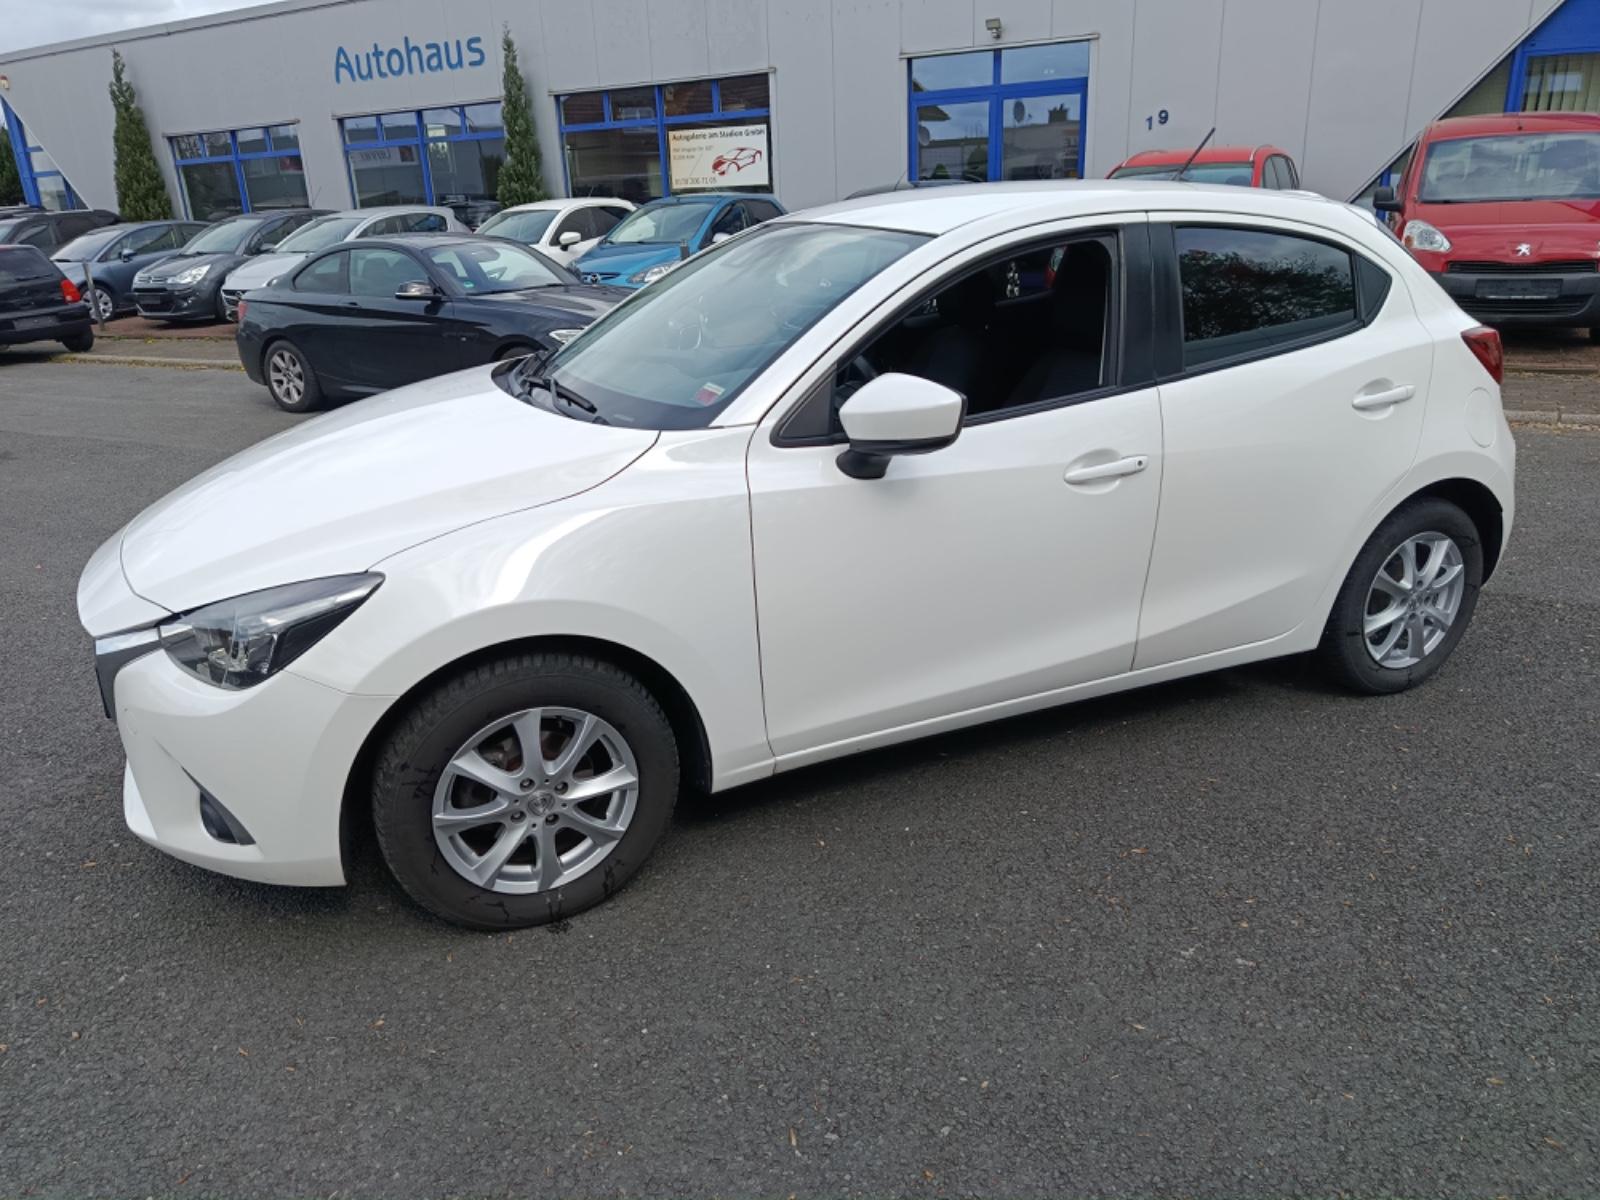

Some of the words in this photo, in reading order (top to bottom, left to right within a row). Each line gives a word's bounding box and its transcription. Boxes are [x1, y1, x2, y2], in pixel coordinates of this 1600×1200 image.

[335, 36, 485, 84] Autohaus
[672, 131, 707, 142] Autogalerie
[708, 131, 719, 139] am
[719, 129, 743, 138] Stadion
[744, 128, 765, 137] GmbH
